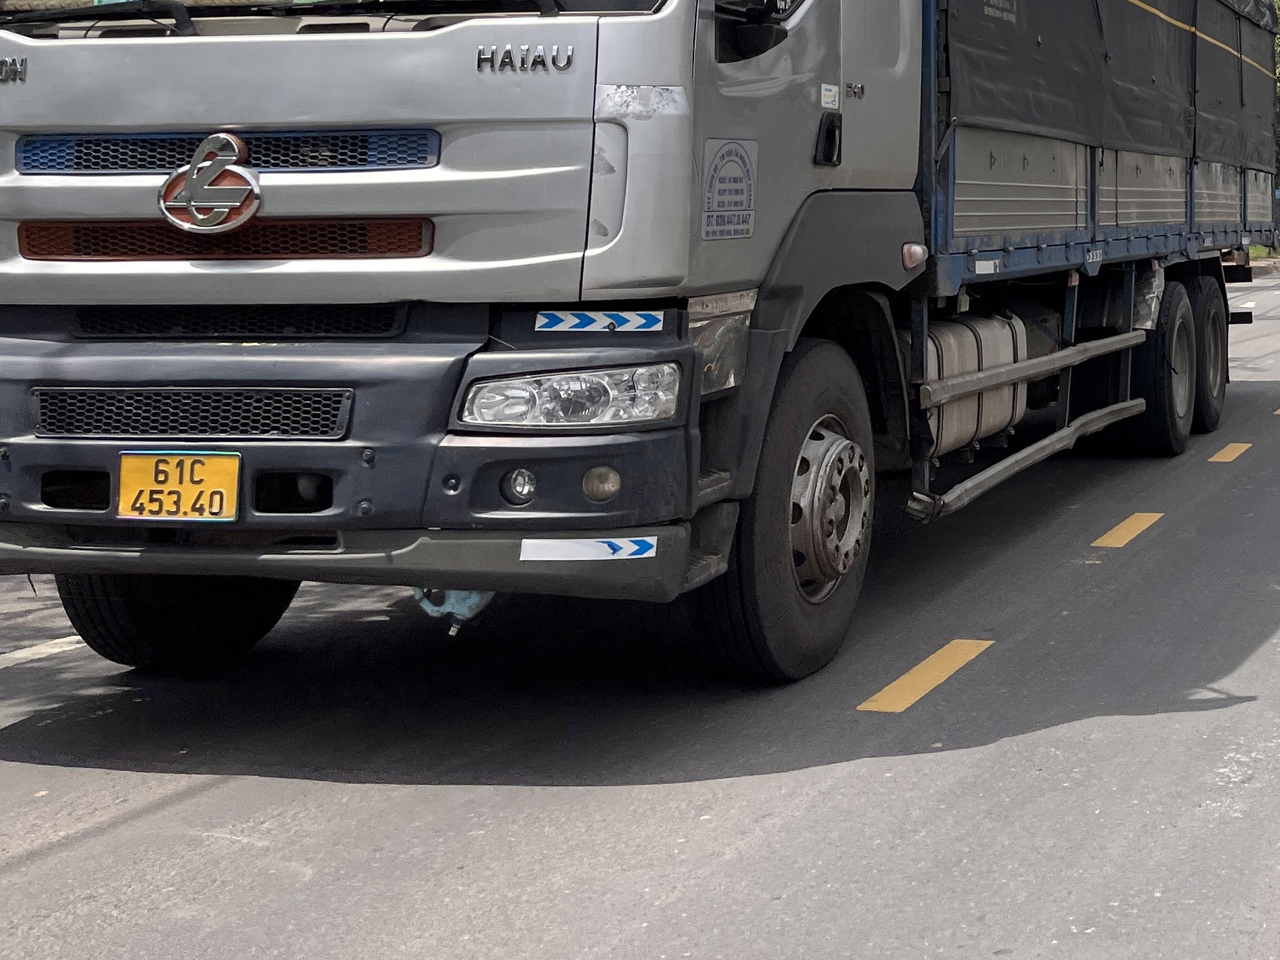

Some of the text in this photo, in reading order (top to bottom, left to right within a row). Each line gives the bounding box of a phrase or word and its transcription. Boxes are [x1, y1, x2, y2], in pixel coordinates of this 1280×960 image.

[477, 40, 575, 73] HAIAU
[153, 458, 206, 486] 61C
[130, 489, 225, 517] 453.40
